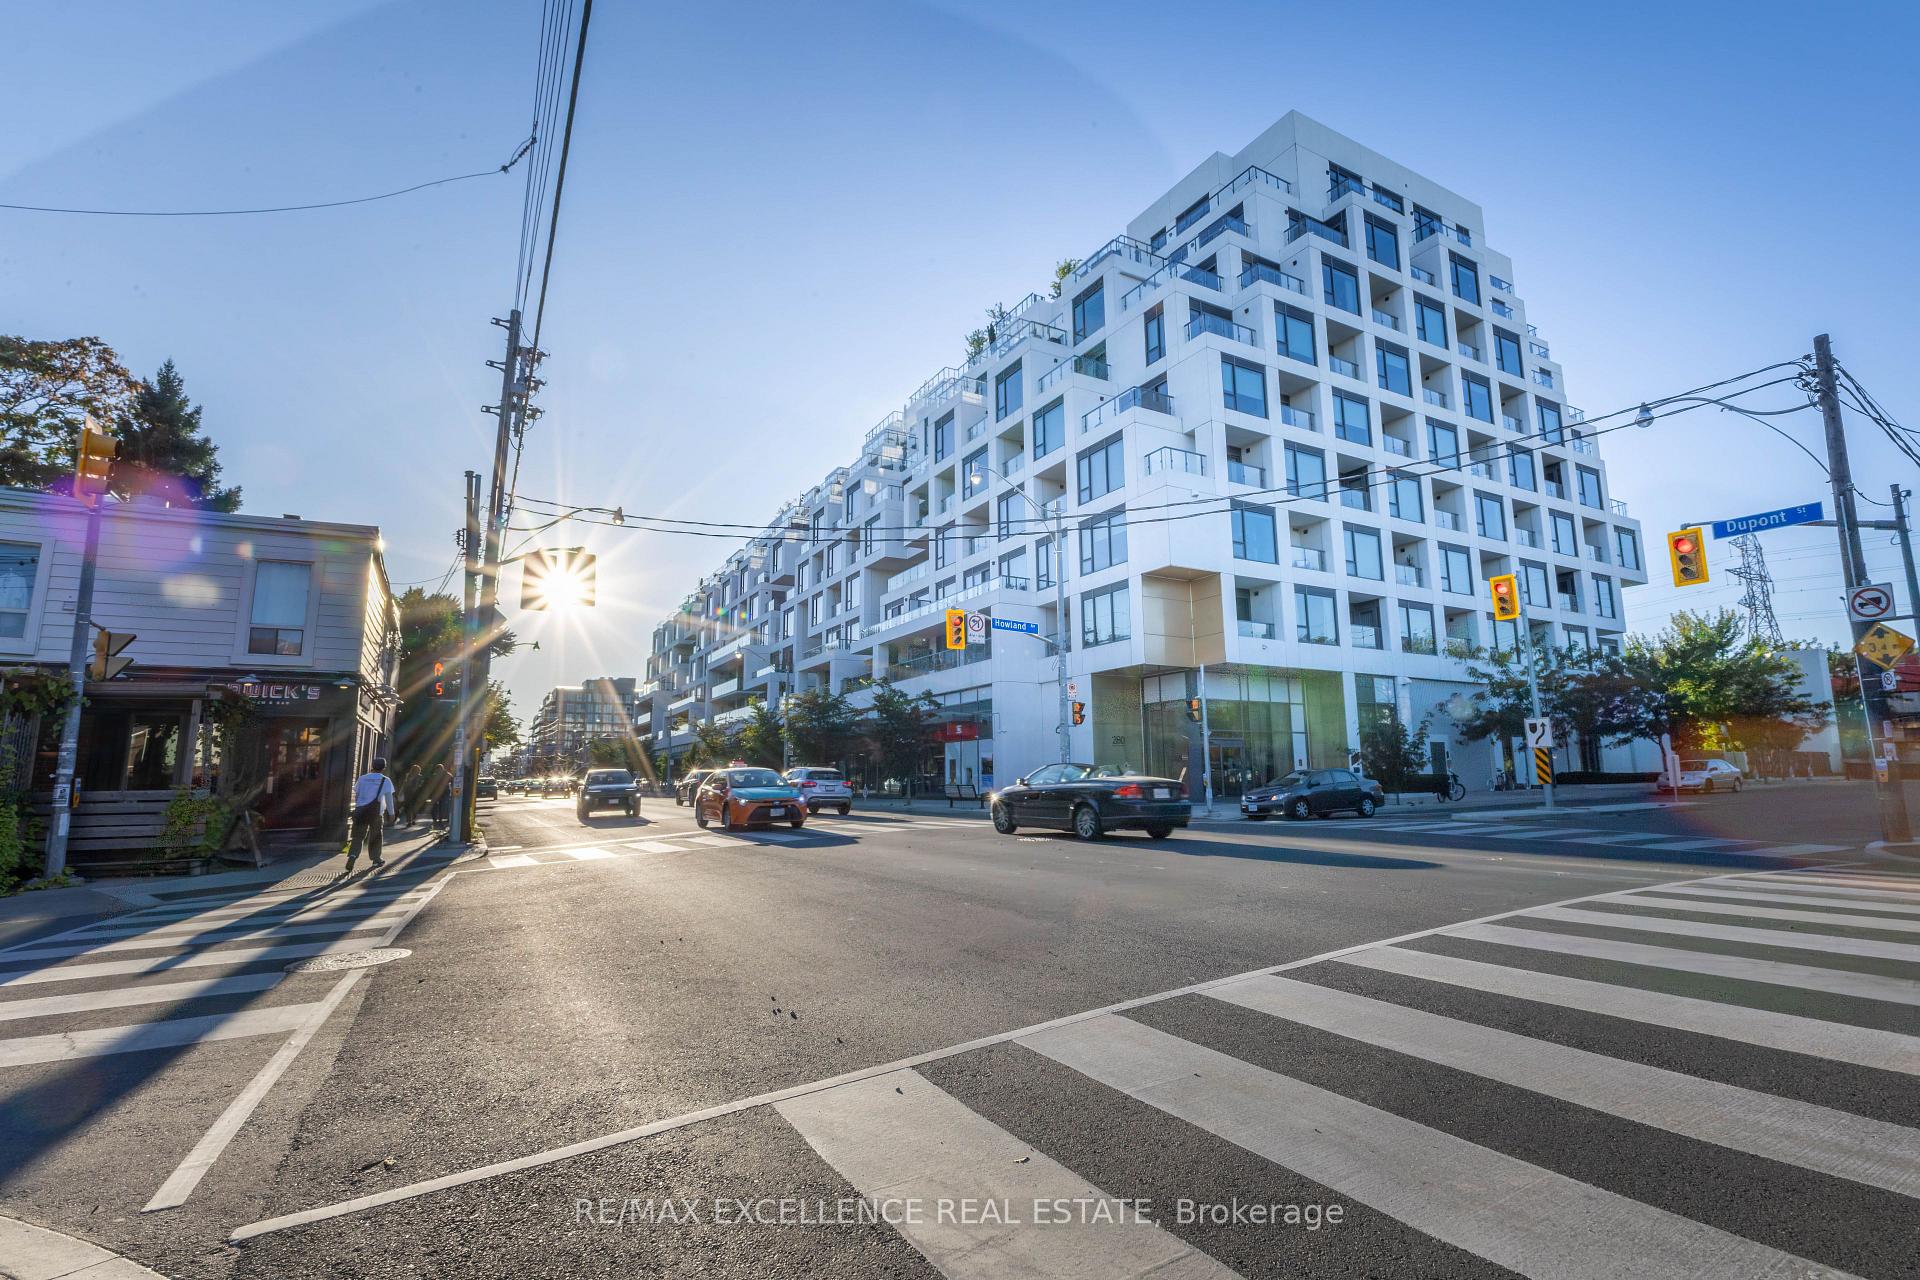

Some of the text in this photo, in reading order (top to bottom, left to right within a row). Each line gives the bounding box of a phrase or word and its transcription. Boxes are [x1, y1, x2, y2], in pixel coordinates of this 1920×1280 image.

[1726, 506, 1806, 532] Dupont St
[995, 619, 1027, 631] Howland
